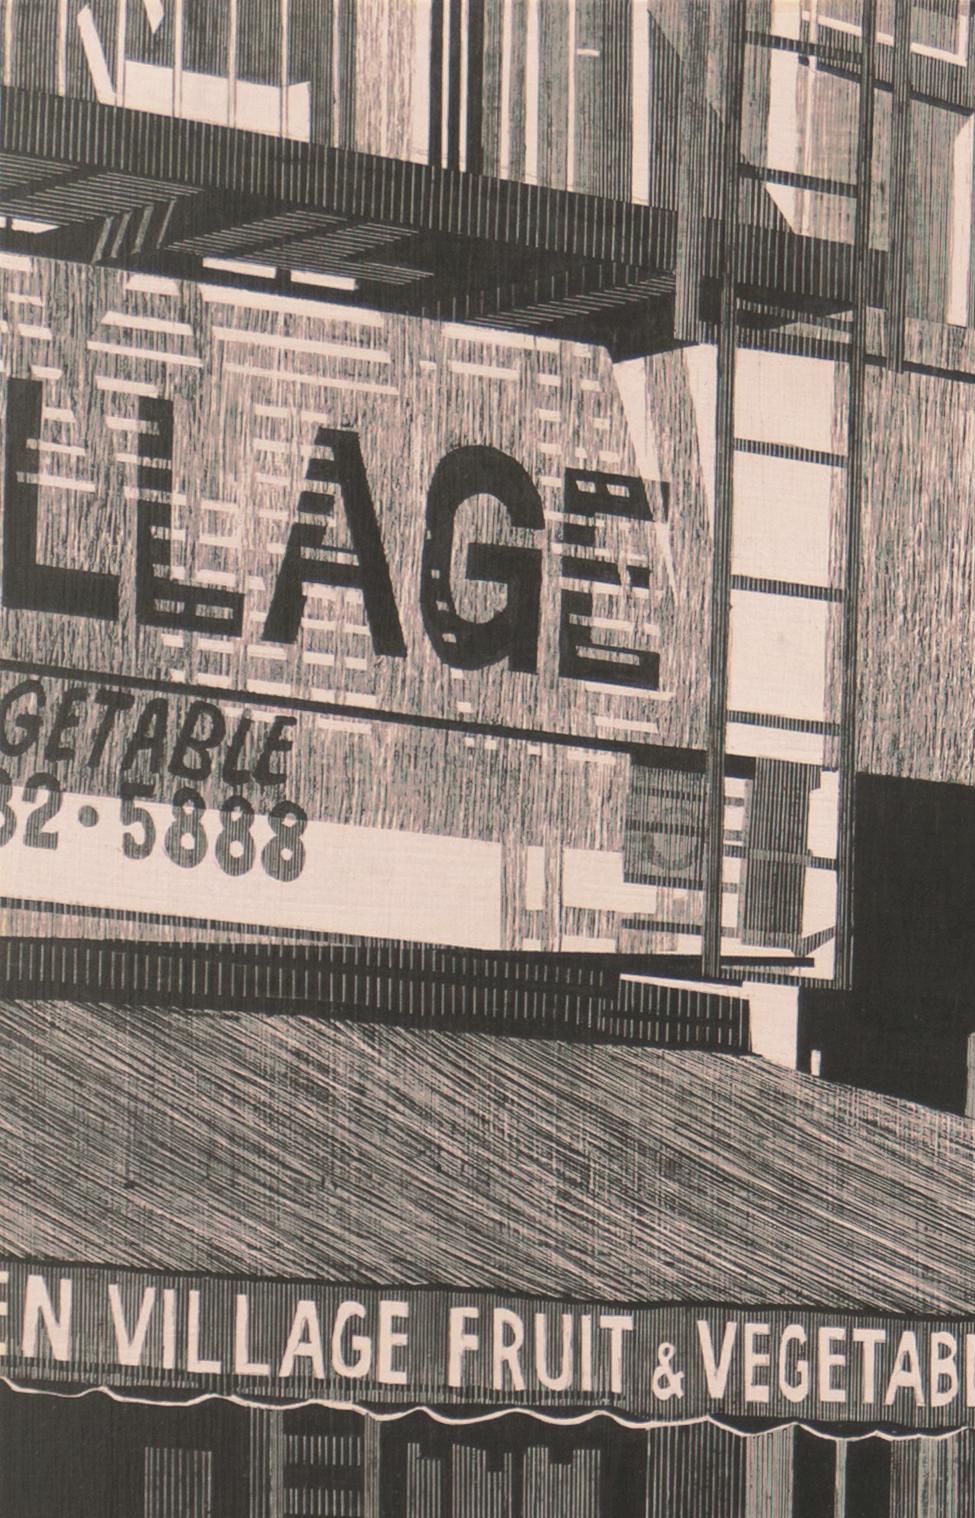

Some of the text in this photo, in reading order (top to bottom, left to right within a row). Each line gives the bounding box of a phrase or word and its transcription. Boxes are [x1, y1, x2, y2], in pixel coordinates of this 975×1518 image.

[2, 378, 670, 691] LLAGE
[0, 679, 298, 787] GETABLE
[108, 1283, 409, 1385] VILLAGE
[447, 1307, 634, 1394] FRUIT
[651, 1341, 685, 1401] &
